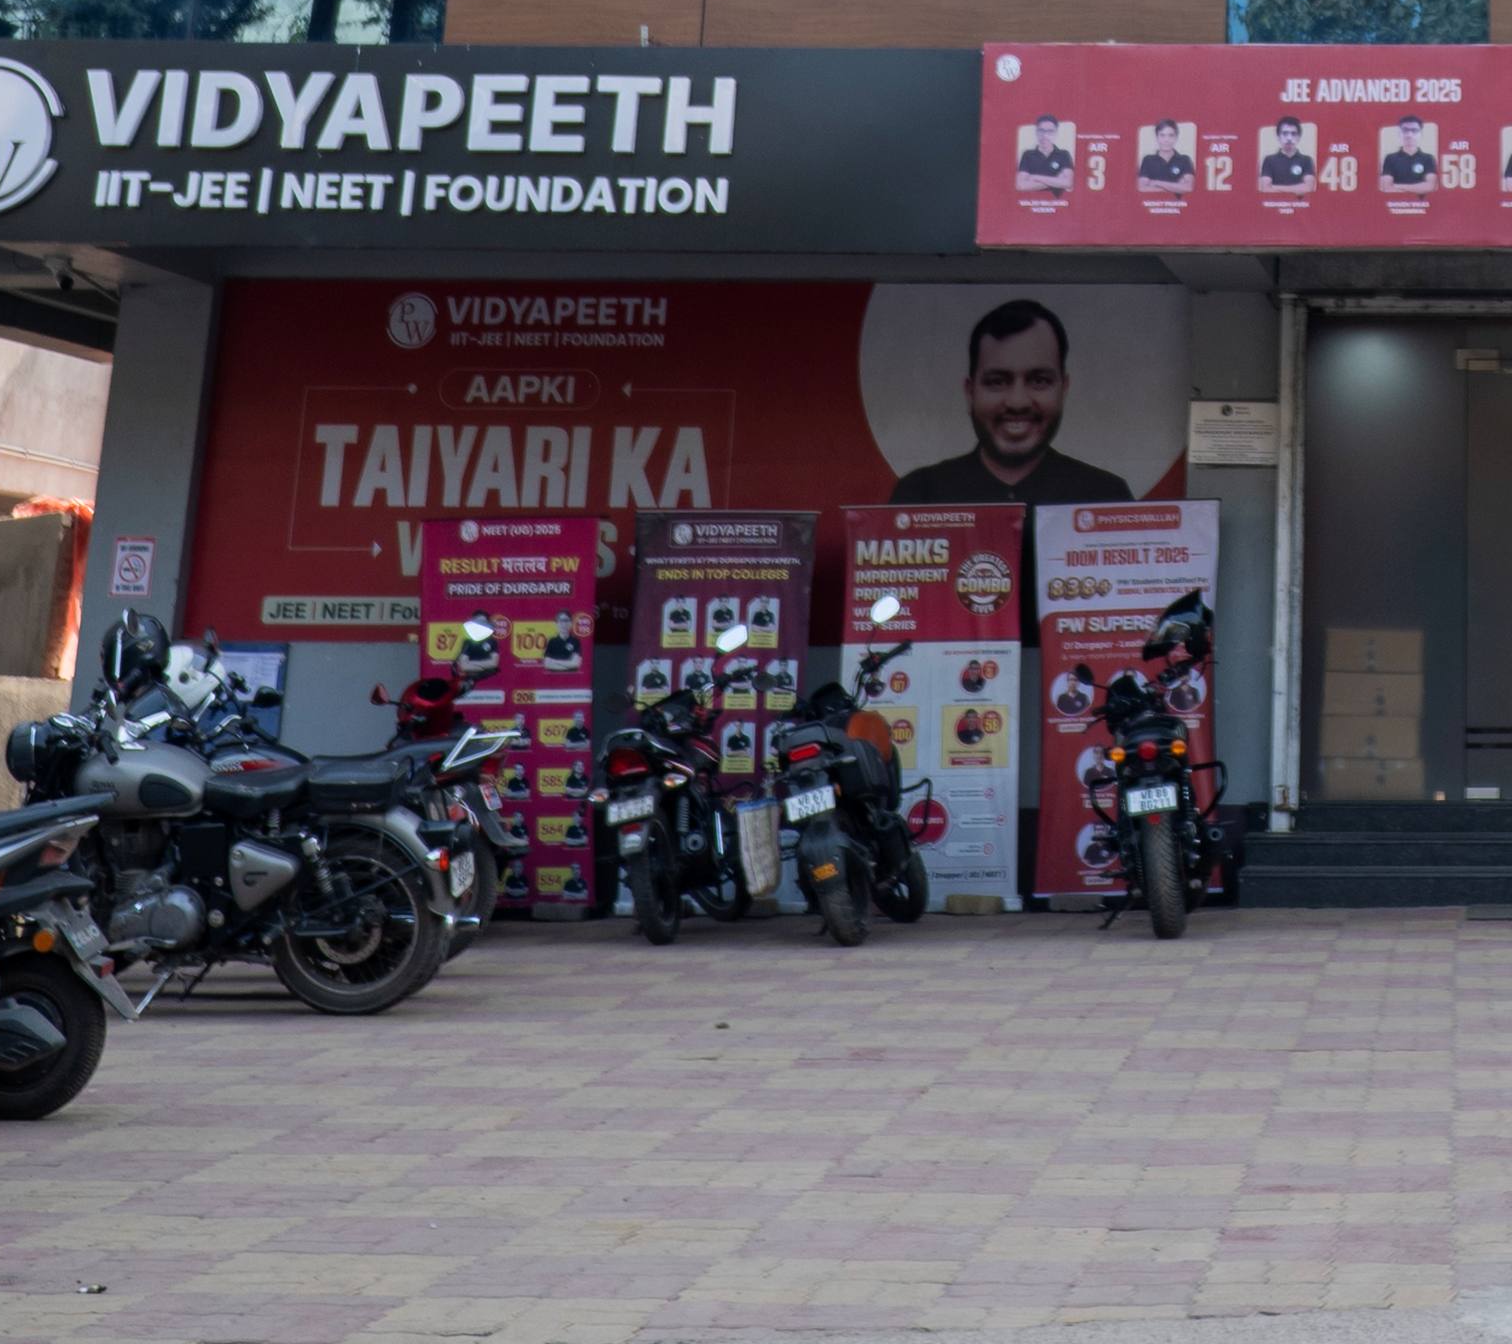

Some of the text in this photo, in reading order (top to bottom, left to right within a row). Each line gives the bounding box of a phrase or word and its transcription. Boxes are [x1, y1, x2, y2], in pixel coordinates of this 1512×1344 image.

[1279, 78, 1462, 104] JEE ADVANCED 2025
[86, 69, 738, 156] VIDYAPEETH
[1089, 143, 1108, 154] AIR
[1210, 143, 1230, 154] AIR
[1330, 143, 1349, 154] AIR
[1450, 141, 1470, 152] AIR
[1087, 157, 1106, 192] 3
[1205, 156, 1233, 192] 12
[1319, 156, 1359, 192] 48
[1441, 154, 1477, 190] 58
[94, 169, 730, 215] IIT-JEE NEET FOUNDATION
[446, 296, 668, 328] VIDYAPEETH
[449, 332, 665, 348] IIT-JEE NEET FOUNDATION
[462, 375, 577, 405] AAPKI
[314, 424, 713, 509] TAIYARI KA
[912, 511, 977, 524] VIDYAPEETH
[1095, 512, 1180, 527] PHYSICSWALLAH
[481, 523, 508, 537] NEET
[695, 523, 779, 538] VIDYAPEETH
[855, 537, 951, 567] MARKS
[1102, 547, 1150, 567] RESULT
[1155, 546, 1190, 564] 2025
[439, 558, 501, 575] RESULT
[550, 556, 581, 574] PW
[656, 568, 791, 581] ENDS IN TOP COLLEGES
[854, 567, 950, 585] IMPROVEMENT
[957, 576, 1013, 594] COMBO
[447, 581, 572, 596] PRIDE OF DURGAPUR
[268, 602, 307, 620] JEE
[321, 602, 376, 620] NEET
[880, 619, 918, 632] SERIES
[1057, 617, 1086, 634] PW
[436, 633, 459, 651] 87
[515, 632, 549, 651] 100
